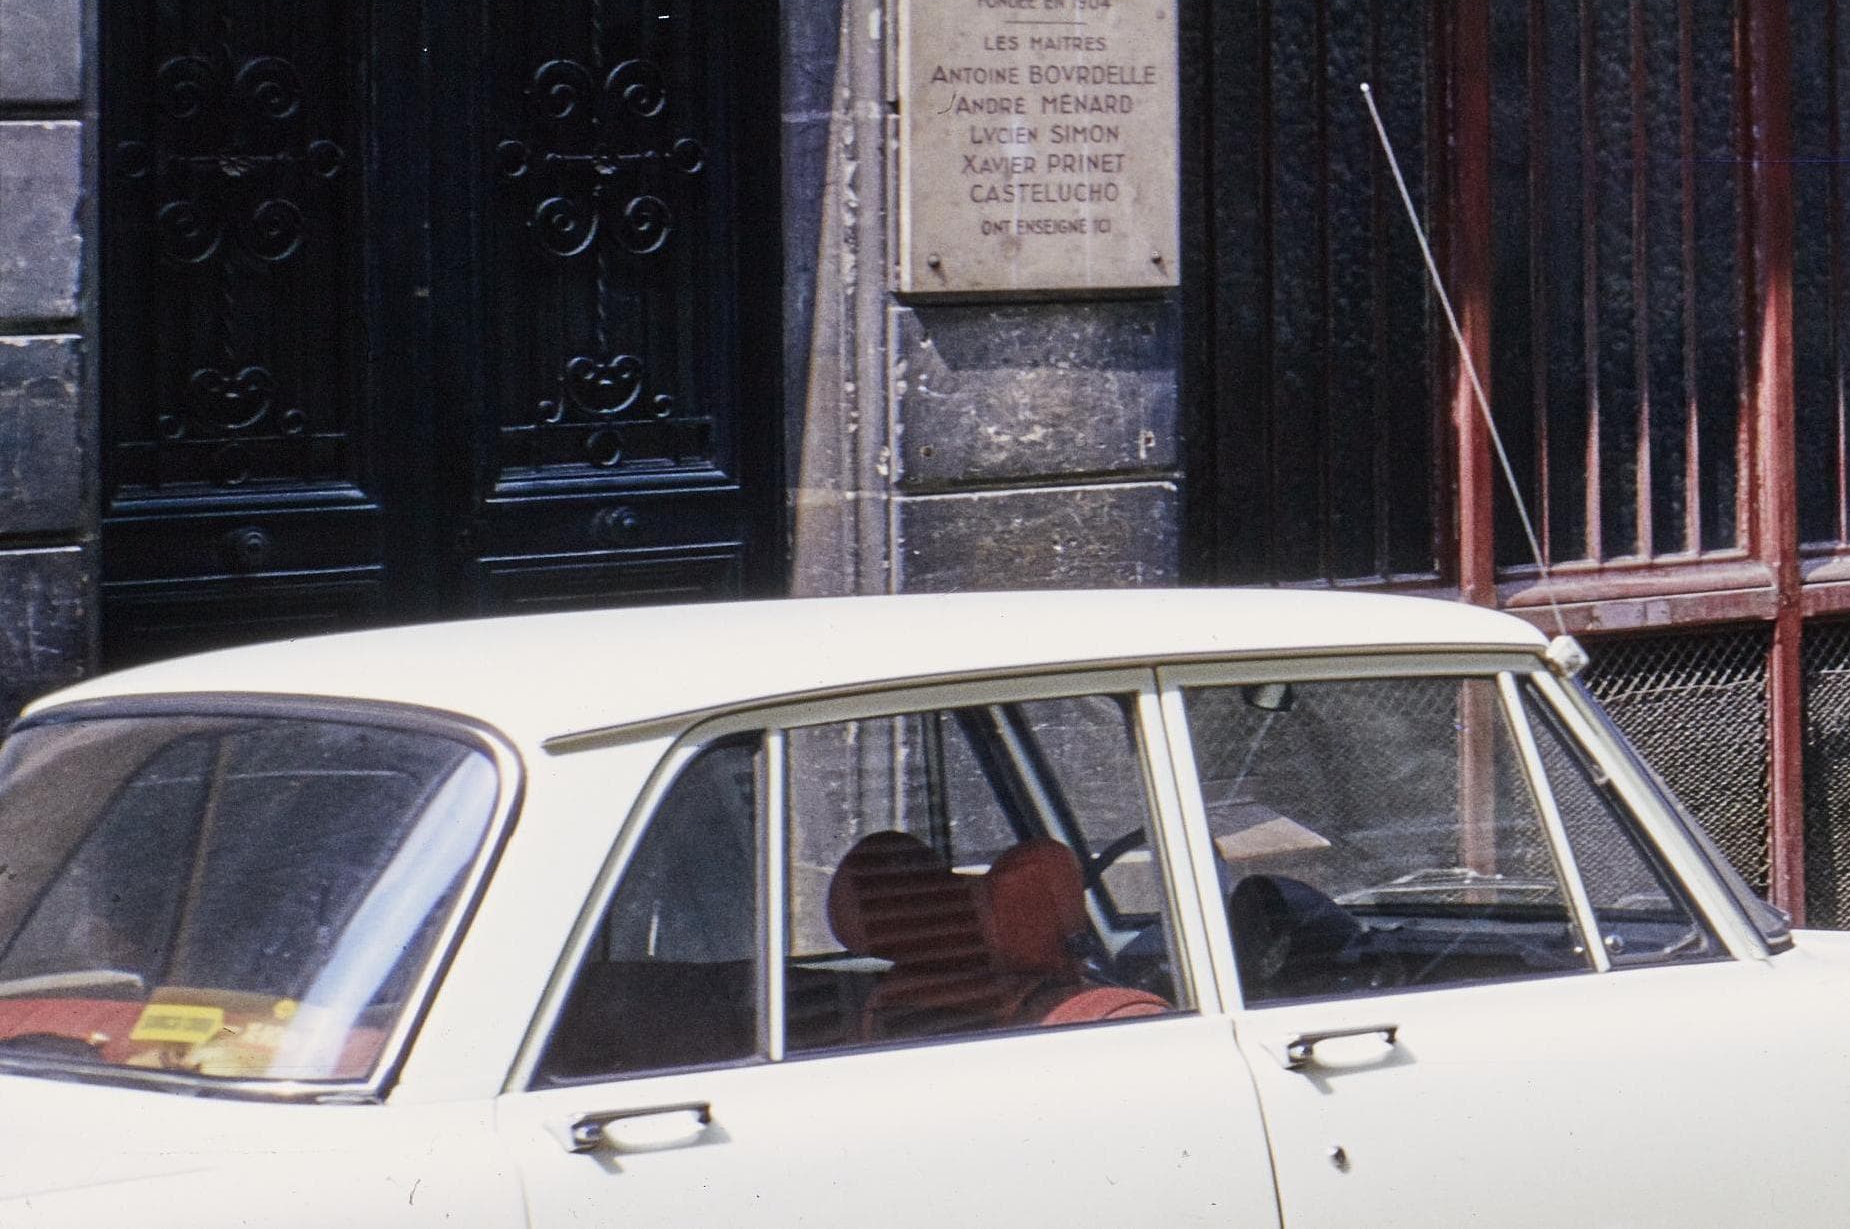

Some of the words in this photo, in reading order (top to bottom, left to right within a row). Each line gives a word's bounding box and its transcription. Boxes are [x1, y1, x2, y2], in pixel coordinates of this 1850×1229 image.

[983, 35, 1019, 52] LES
[1050, 124, 1120, 145] SIMON
[1047, 153, 1126, 174] PRINET
[970, 182, 1120, 204] CASTELUCHO
[980, 219, 1011, 236] ONT
